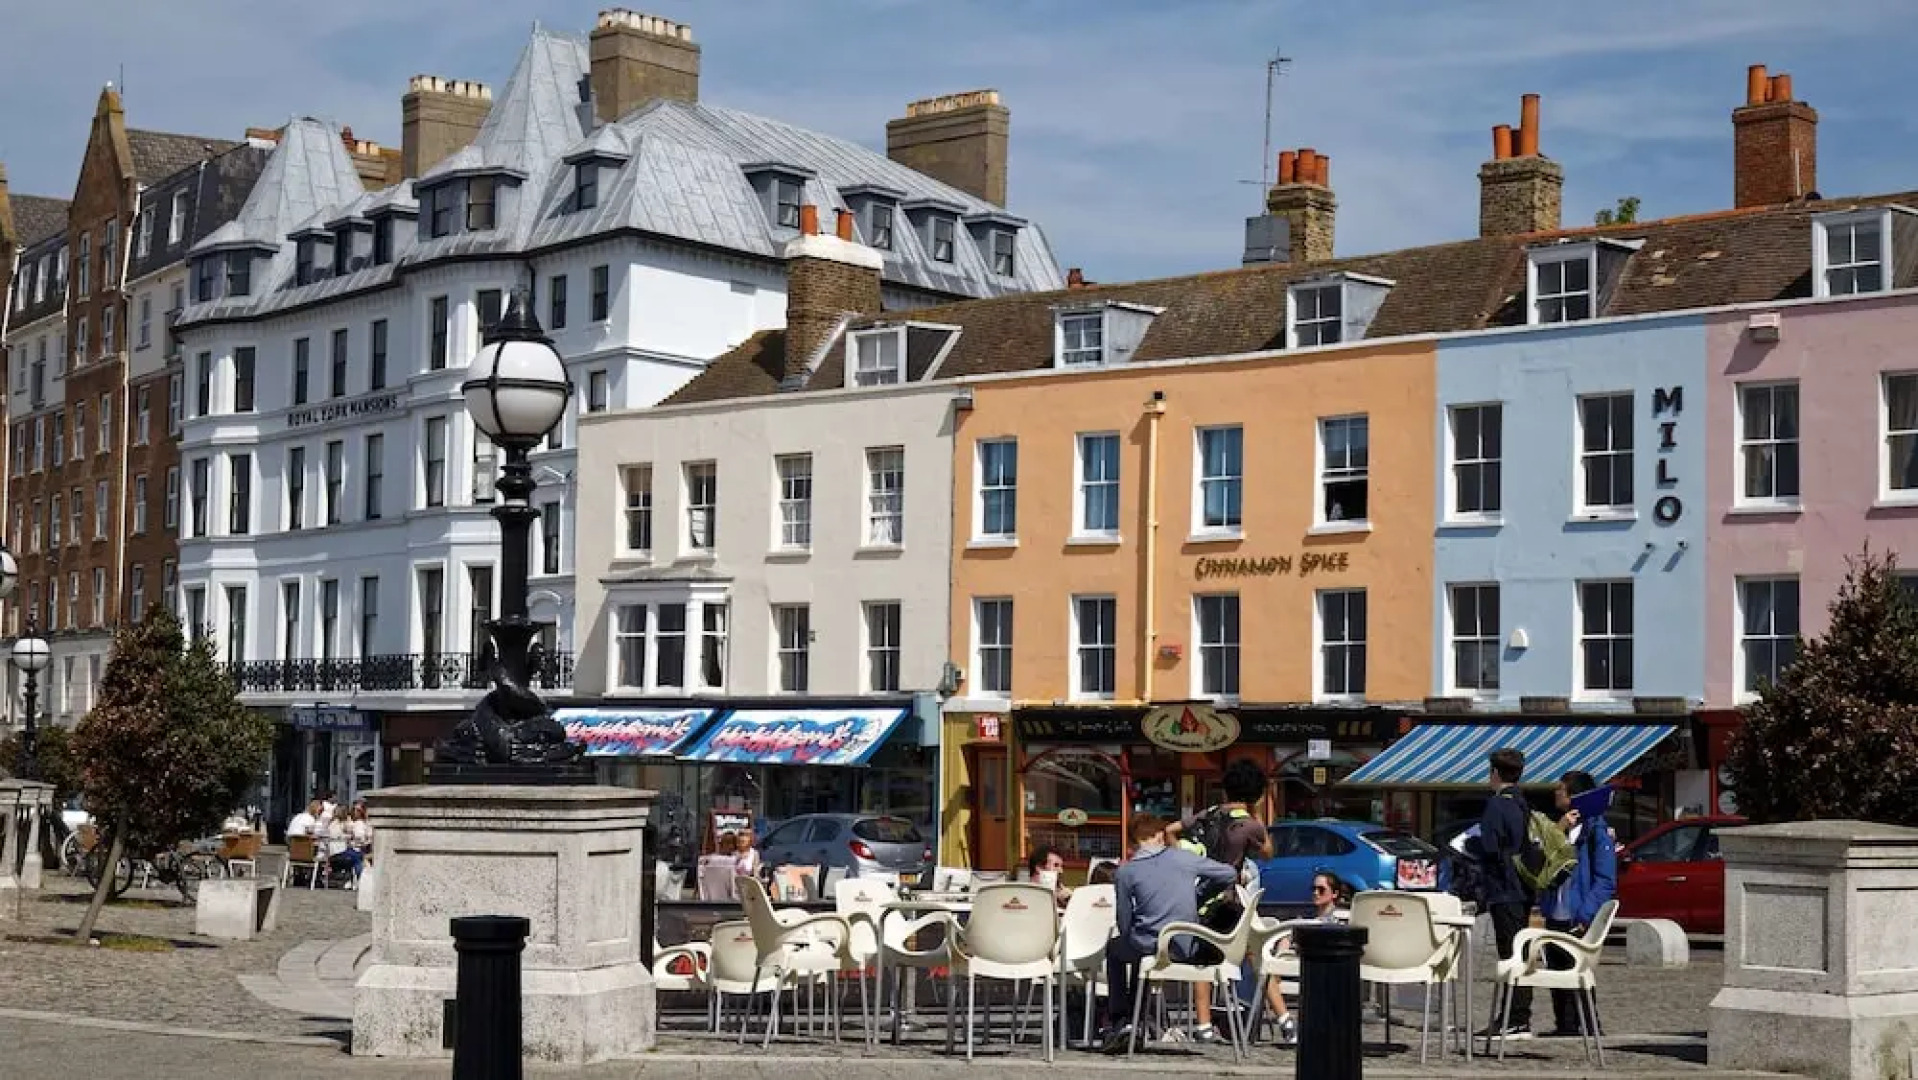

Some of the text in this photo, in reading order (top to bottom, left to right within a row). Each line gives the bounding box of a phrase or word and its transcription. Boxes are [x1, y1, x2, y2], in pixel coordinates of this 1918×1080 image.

[287, 395, 398, 427] ROYAL YORK MANSIONS
[1653, 386, 1684, 522] MILO
[1195, 552, 1349, 580] CINNAMON SPICE
